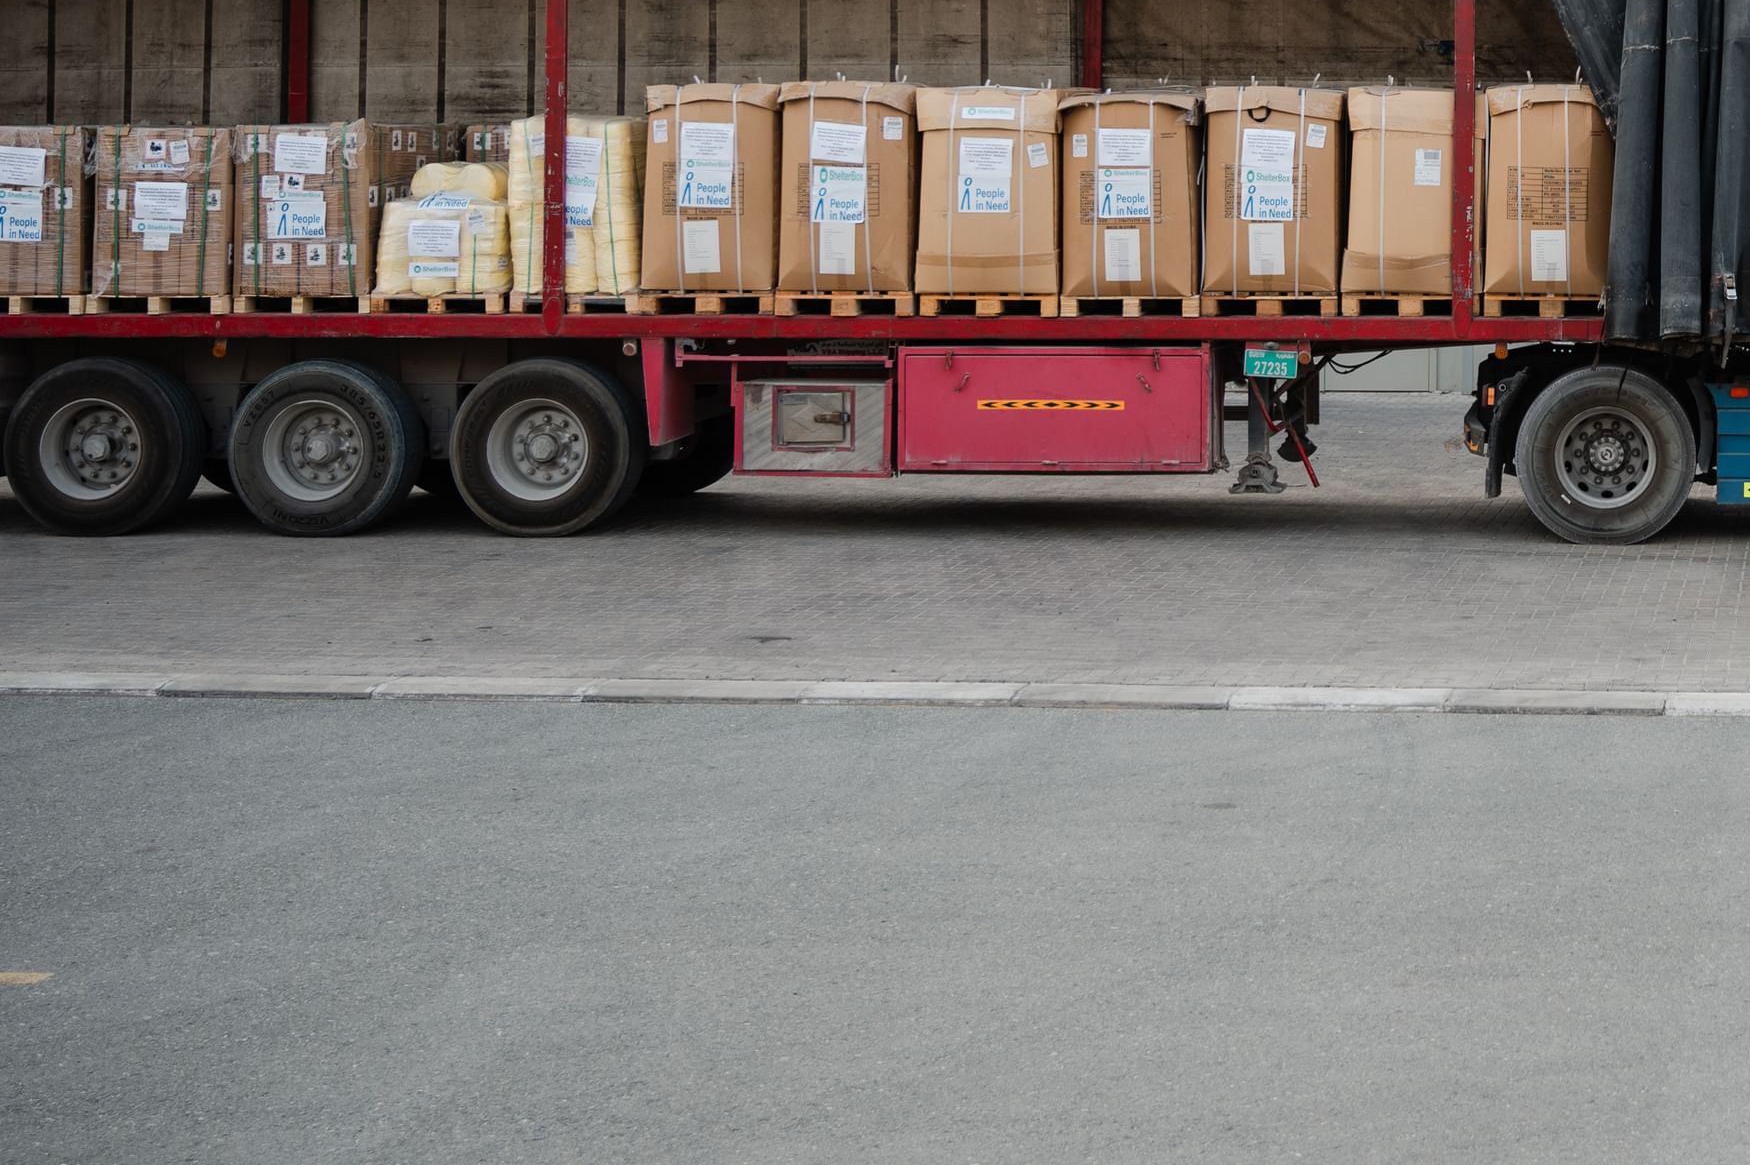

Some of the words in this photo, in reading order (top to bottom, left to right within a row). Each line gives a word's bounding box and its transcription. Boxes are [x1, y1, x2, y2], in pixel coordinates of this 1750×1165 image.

[566, 175, 595, 187] helterBox
[829, 170, 863, 182] ShelterBox
[1256, 172, 1290, 182] ShelterBox
[697, 182, 726, 194] People
[976, 188, 1005, 200] People
[696, 196, 704, 204] in
[706, 196, 730, 205] Need
[830, 198, 859, 211] People
[1116, 194, 1145, 205] People
[1260, 196, 1288, 208] People
[976, 201, 983, 210] in
[986, 201, 1008, 210] Need
[565, 206, 588, 216] eople
[830, 211, 838, 220] in
[839, 211, 862, 221] Need
[1116, 206, 1124, 216] in
[1127, 206, 1149, 216] Need
[1259, 209, 1267, 218] in
[1269, 209, 1291, 219] Need
[9, 217, 38, 228] People
[292, 214, 321, 225] People
[570, 216, 592, 226] Need
[9, 230, 17, 239] in
[18, 230, 40, 239] Need
[292, 226, 300, 236] in
[302, 226, 324, 236] Need
[1254, 361, 1288, 376] 27235
